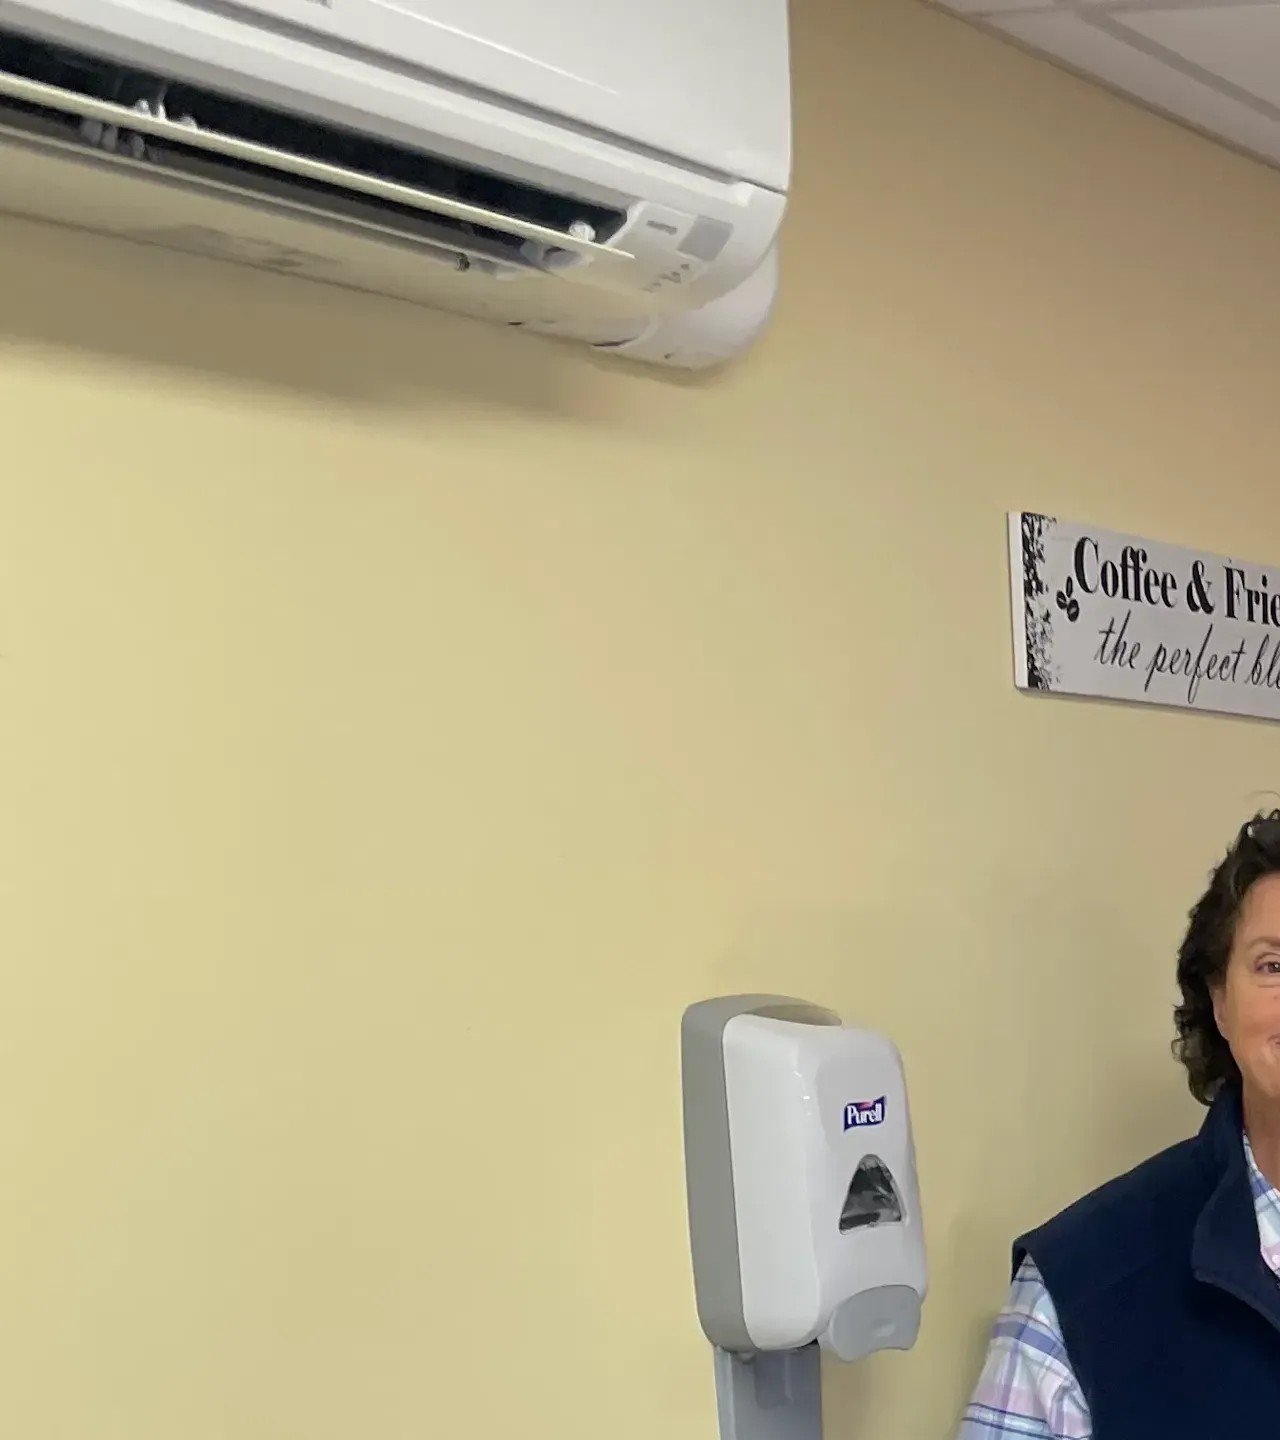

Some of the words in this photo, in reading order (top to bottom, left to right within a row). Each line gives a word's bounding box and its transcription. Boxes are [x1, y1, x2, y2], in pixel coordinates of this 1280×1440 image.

[1074, 535, 1177, 609] Coffee
[1186, 559, 1215, 615] &
[1094, 609, 1141, 670] the
[1144, 623, 1246, 704] perfect
